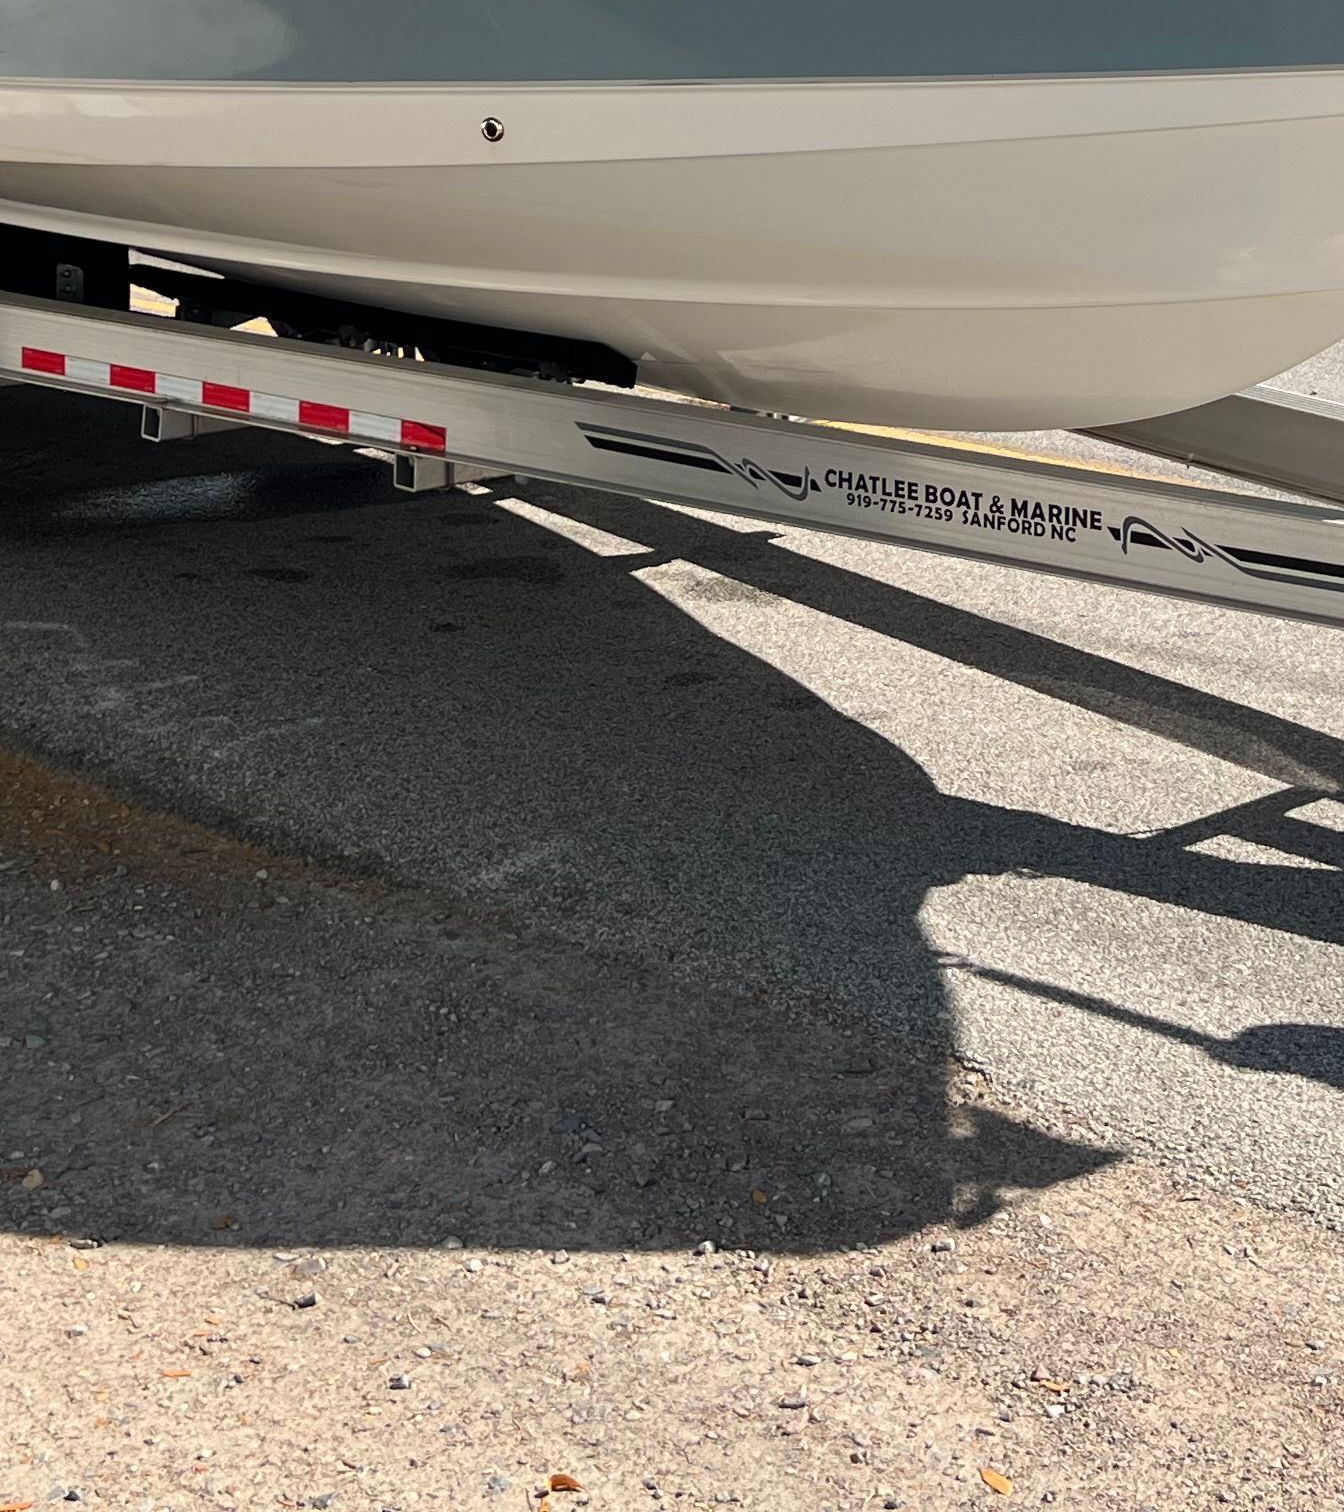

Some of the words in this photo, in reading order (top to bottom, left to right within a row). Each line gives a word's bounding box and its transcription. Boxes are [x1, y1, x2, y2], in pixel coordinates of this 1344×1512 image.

[824, 469, 919, 501] CHATLEE
[925, 484, 983, 511] BOAT
[989, 495, 1005, 514] &
[1010, 498, 1102, 531] MARINE
[846, 493, 953, 521] 919-775-7259
[962, 510, 1046, 537] SANFORD
[1051, 524, 1077, 543] NC
